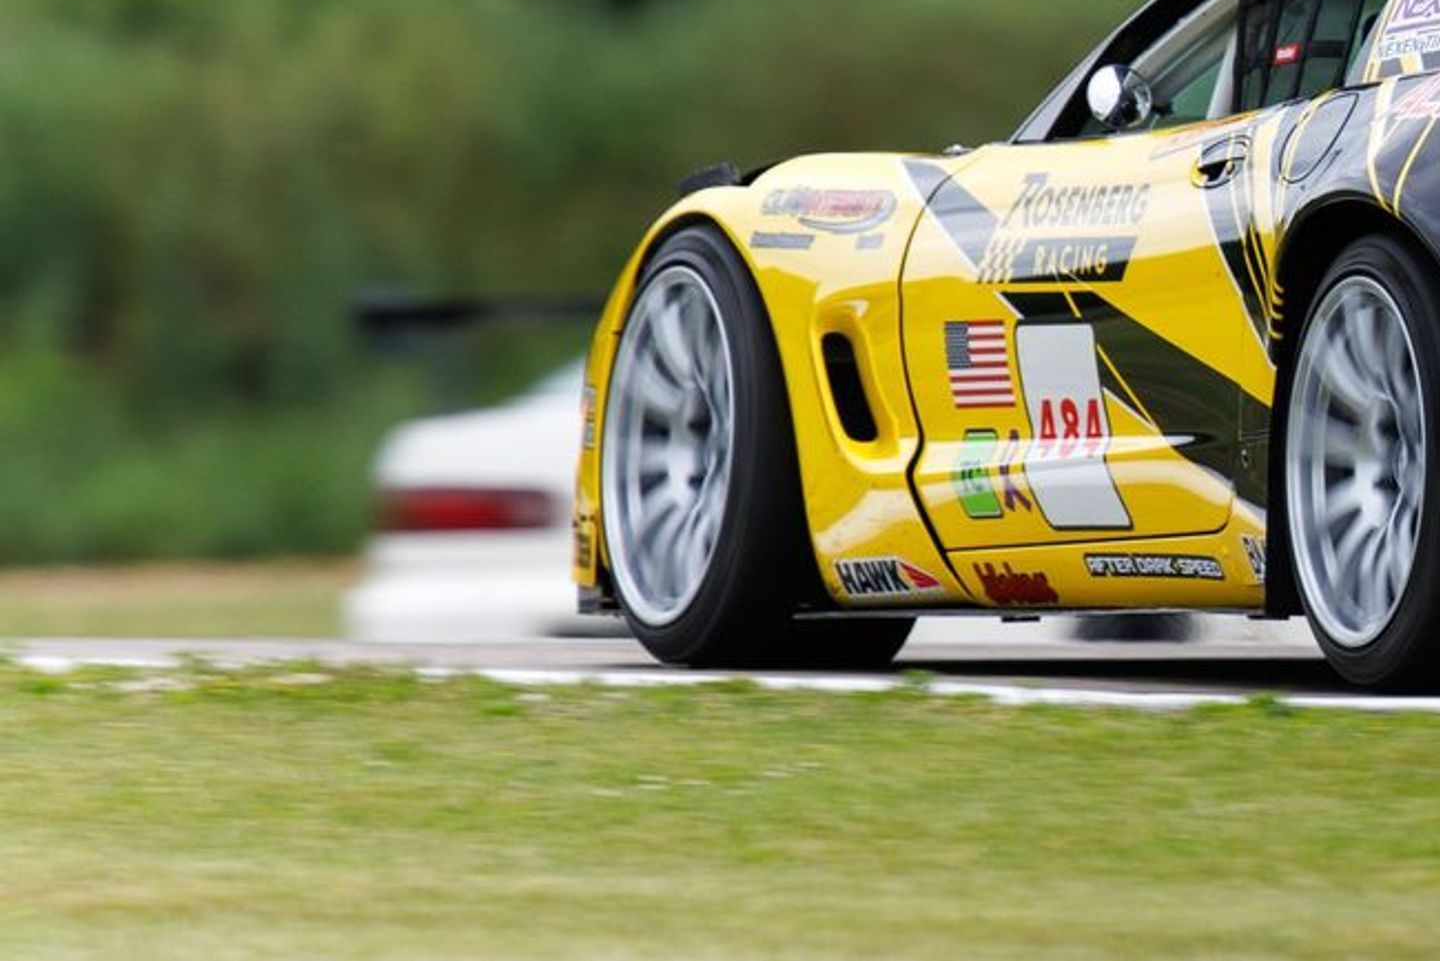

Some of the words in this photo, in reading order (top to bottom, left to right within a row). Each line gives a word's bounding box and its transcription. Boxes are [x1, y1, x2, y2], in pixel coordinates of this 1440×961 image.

[1001, 172, 1151, 228] ROSENBERG
[1033, 244, 1110, 276] RACING
[1039, 397, 1103, 459] 484
[835, 559, 911, 594] HAWK
